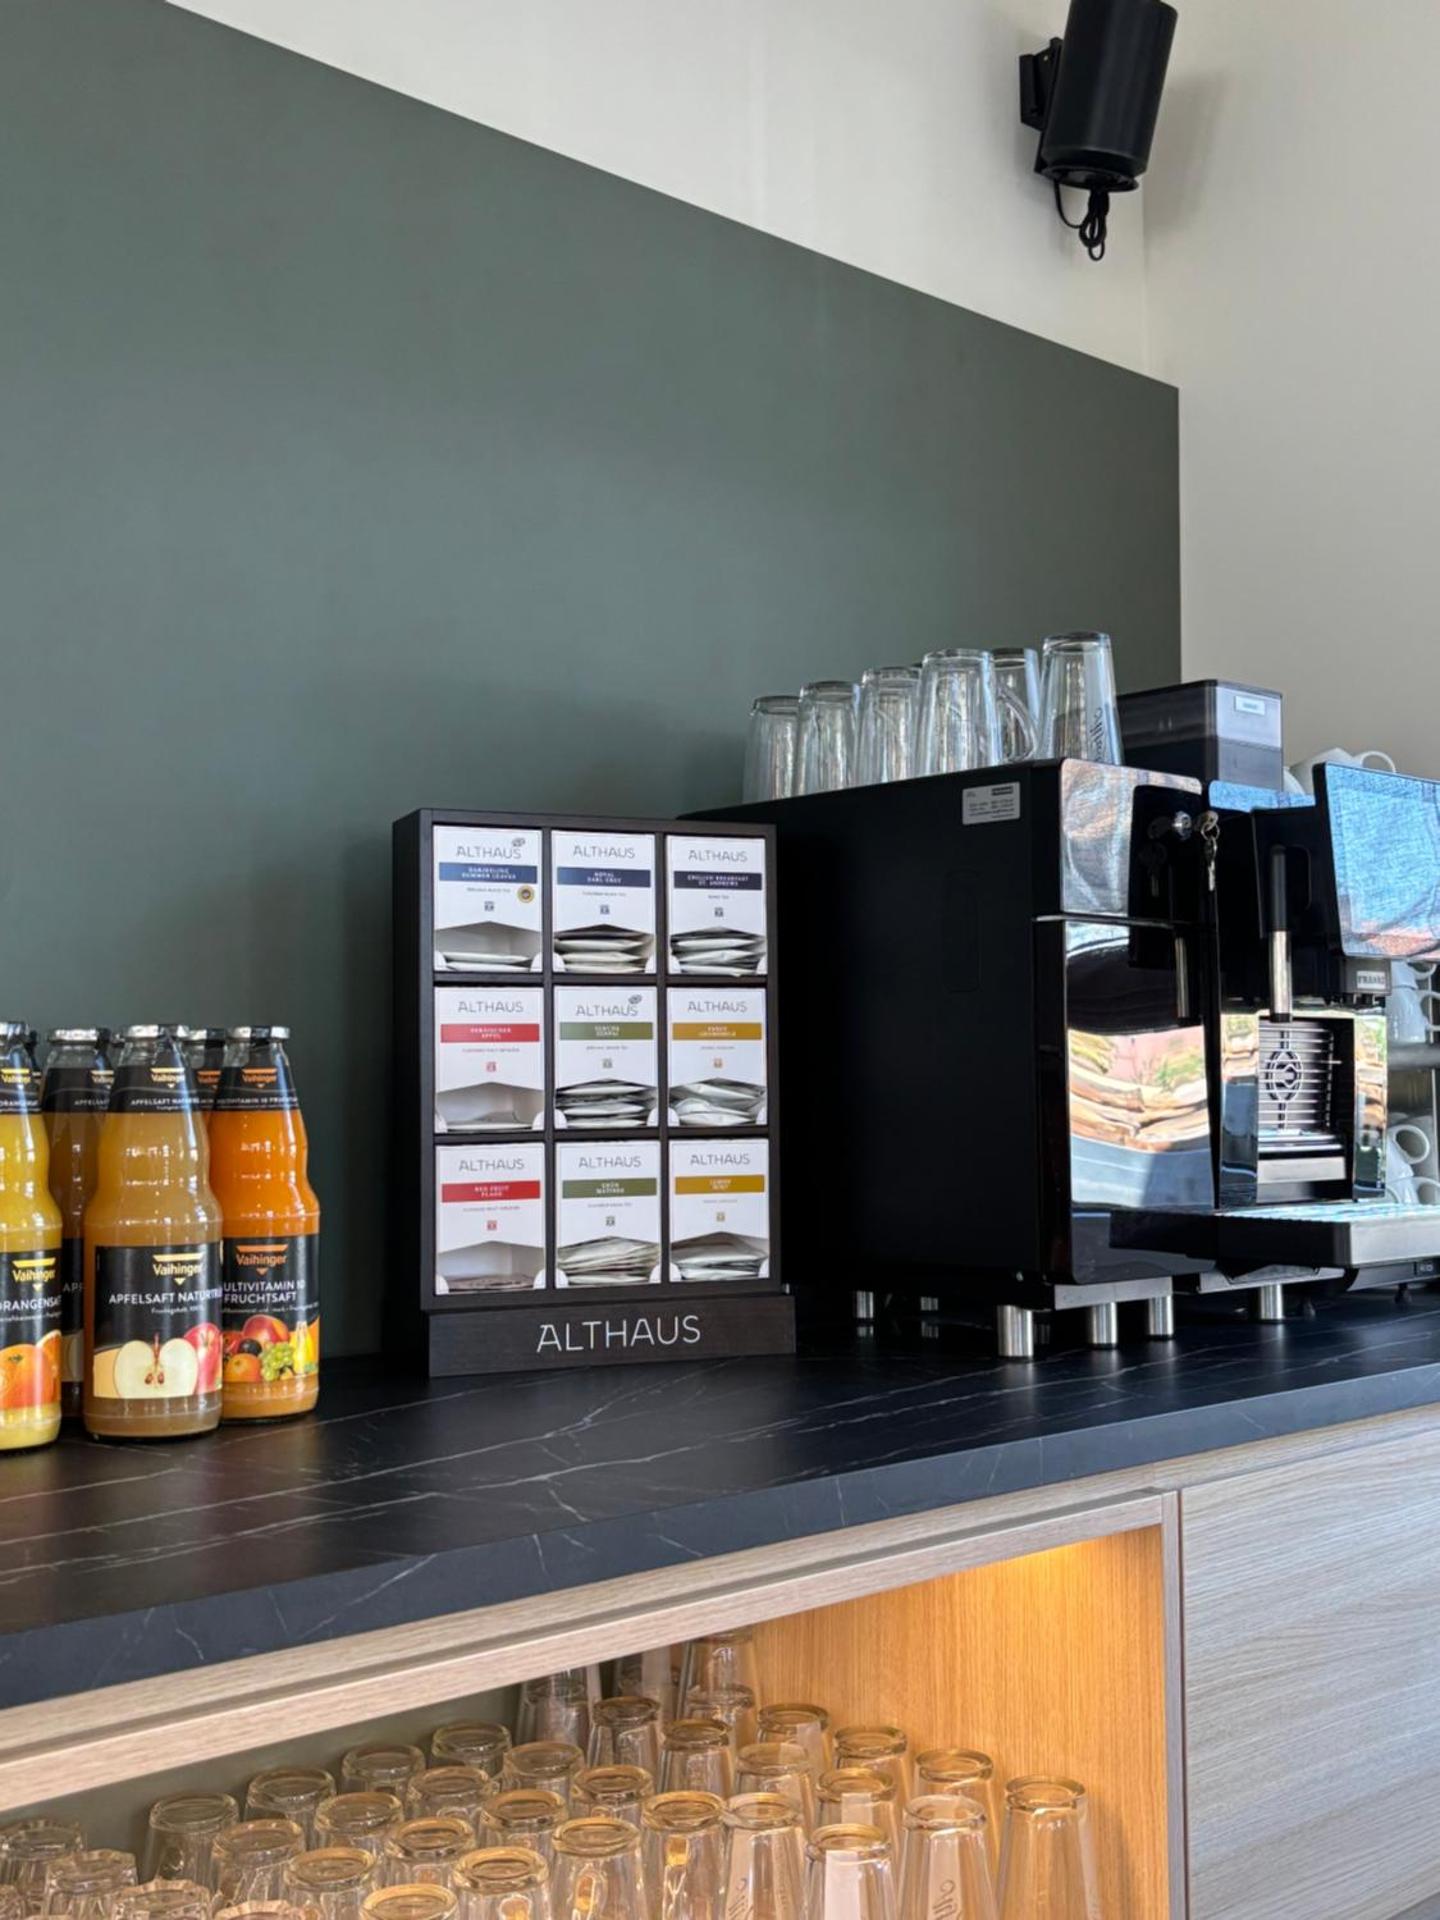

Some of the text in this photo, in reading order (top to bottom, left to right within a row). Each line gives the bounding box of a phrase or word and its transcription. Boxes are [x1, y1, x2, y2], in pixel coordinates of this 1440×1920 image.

[456, 846, 522, 859] ALTHAUS
[573, 845, 636, 859] ALTHAUS
[688, 850, 749, 863] ALTHAUS
[457, 1001, 525, 1013] ALTHAUS
[576, 1005, 639, 1017] ALTHAUS
[687, 1001, 748, 1013] ALTHAUS
[459, 1159, 525, 1172] ALTHAUS
[578, 1156, 642, 1168] ALTHAUS
[690, 1153, 751, 1166] ALTHAUS
[236, 1253, 287, 1268] Vaihinger
[12, 1269, 56, 1283] Vaihinger
[153, 1263, 206, 1277] Vaihinger
[109, 1292, 176, 1304] APFELSAFT
[223, 1291, 297, 1305] FRUCHTSAFT
[536, 1315, 701, 1352] ALTHAUS
